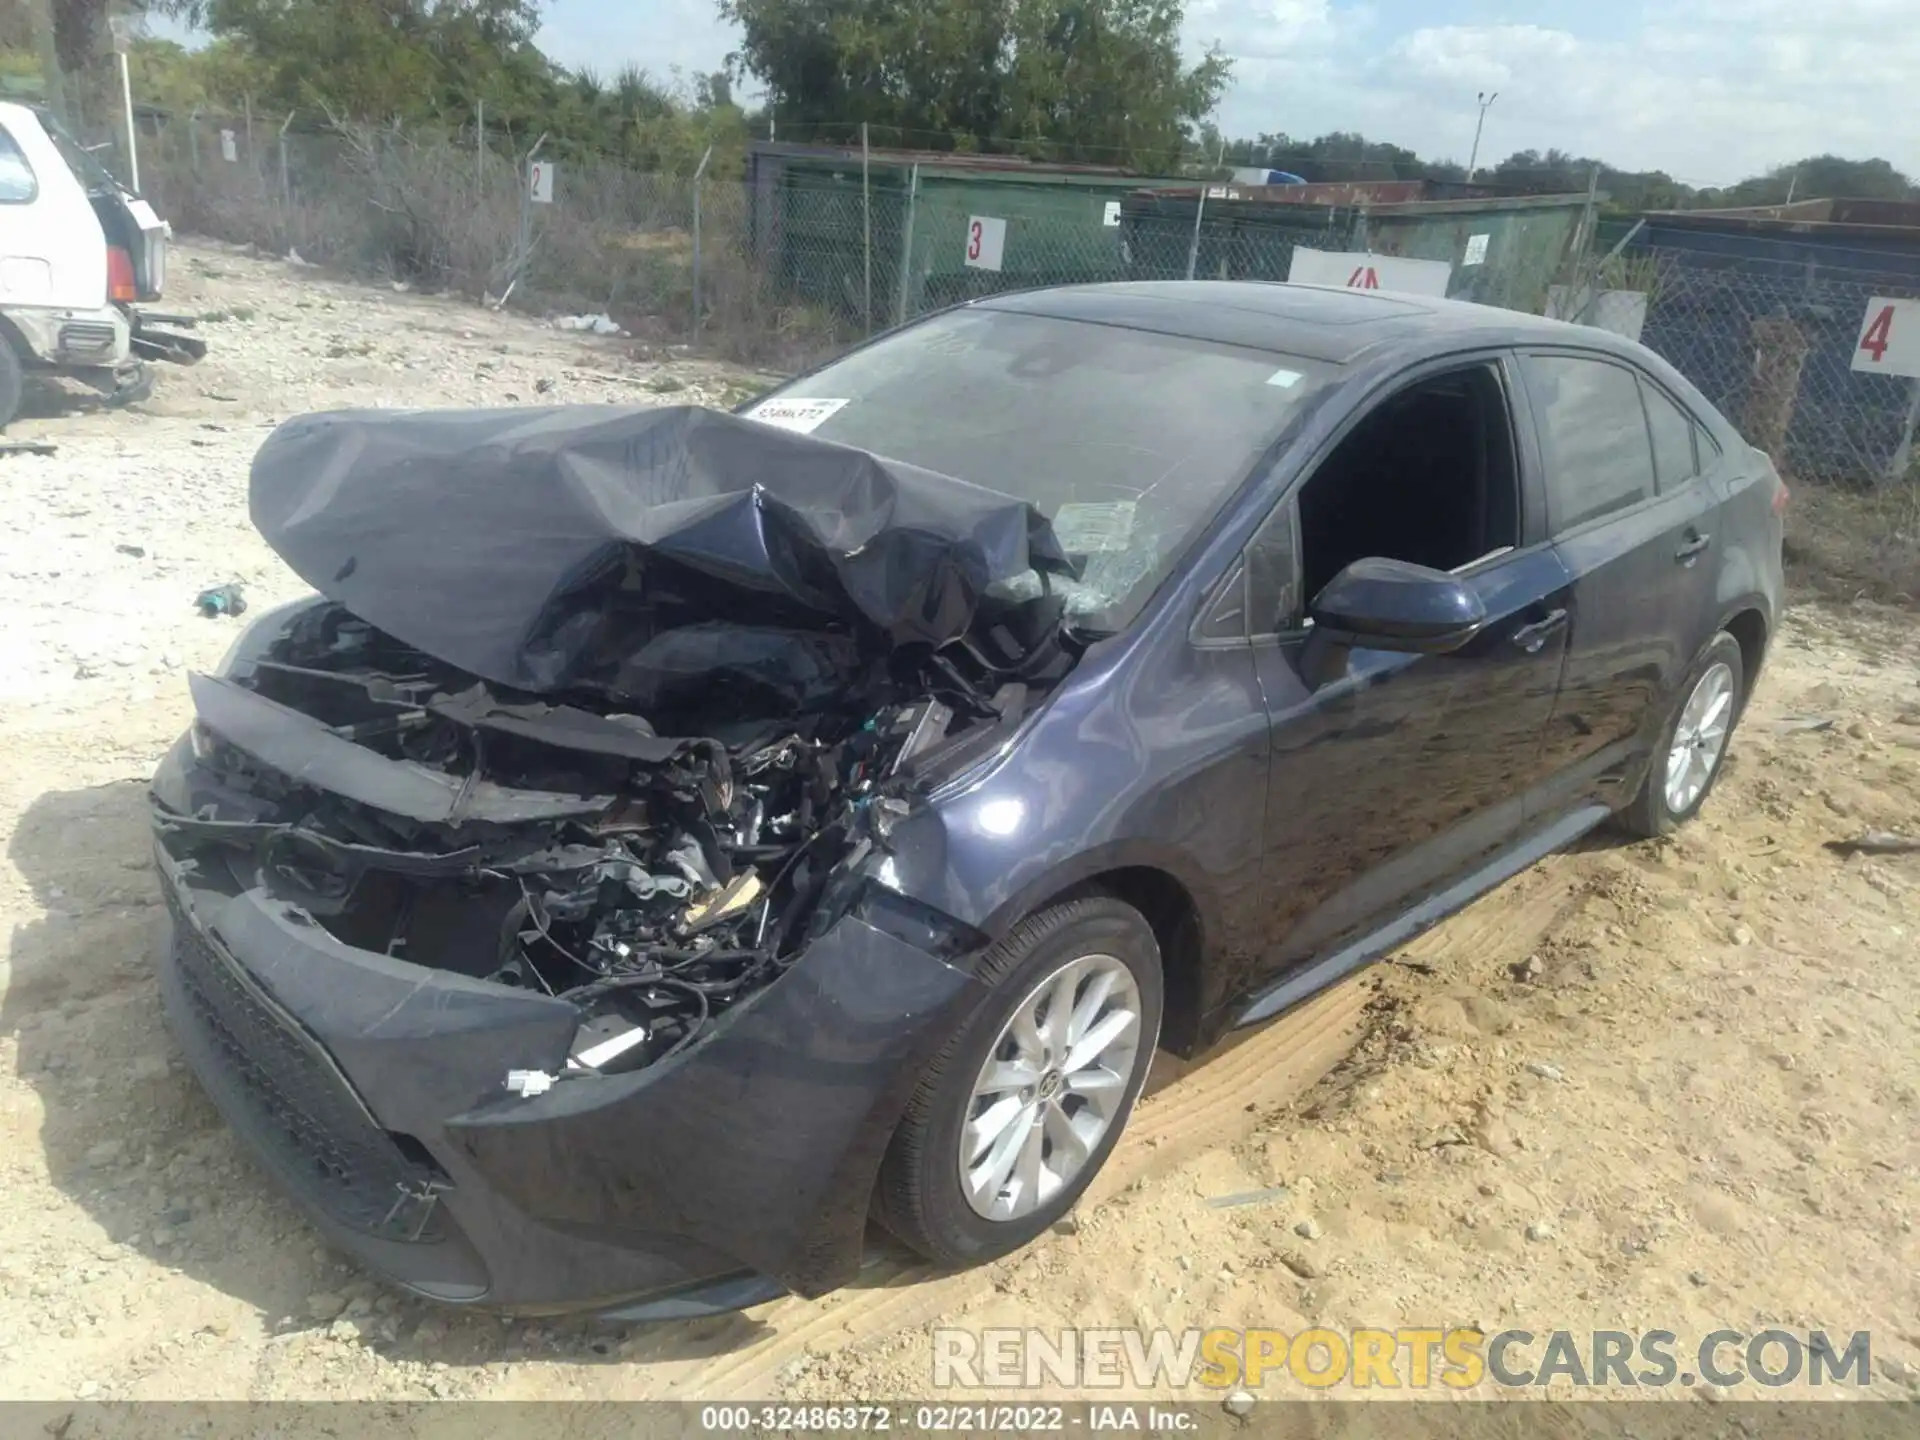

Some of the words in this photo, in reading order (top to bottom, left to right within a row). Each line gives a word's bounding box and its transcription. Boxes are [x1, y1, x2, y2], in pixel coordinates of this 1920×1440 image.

[533, 167, 540, 197] 2
[968, 221, 982, 260] 3
[1860, 305, 1895, 362] 4
